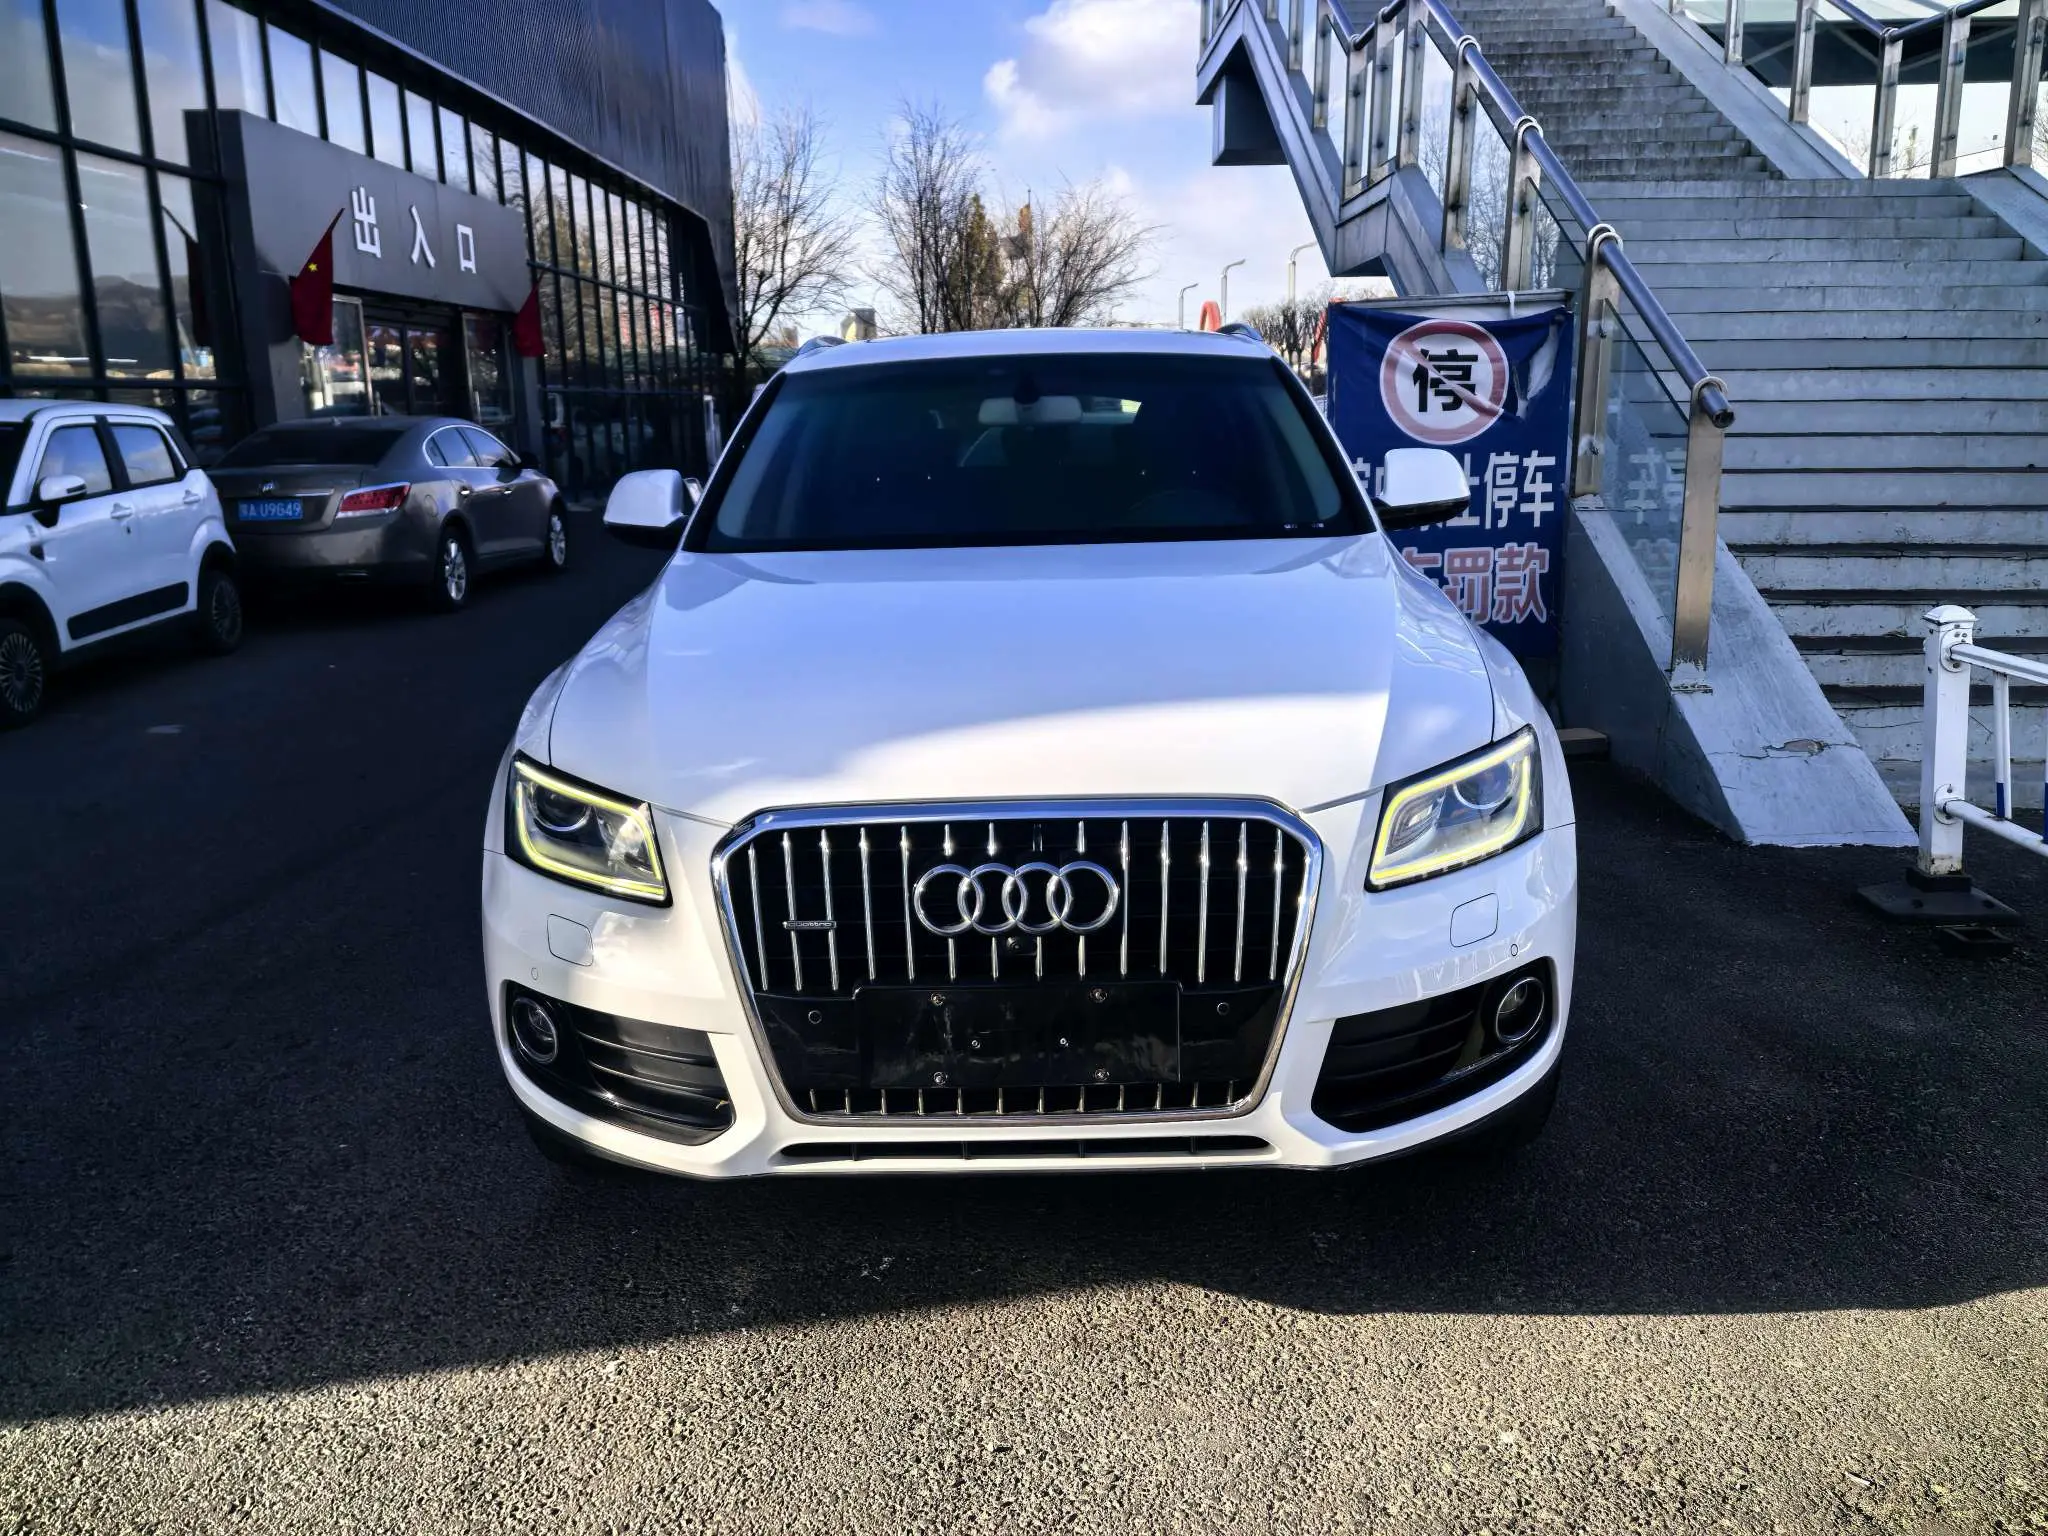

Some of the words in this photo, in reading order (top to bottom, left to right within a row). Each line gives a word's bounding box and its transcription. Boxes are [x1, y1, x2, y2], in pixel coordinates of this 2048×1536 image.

[351, 186, 477, 274] 出入口
[1412, 348, 1479, 413] 停
